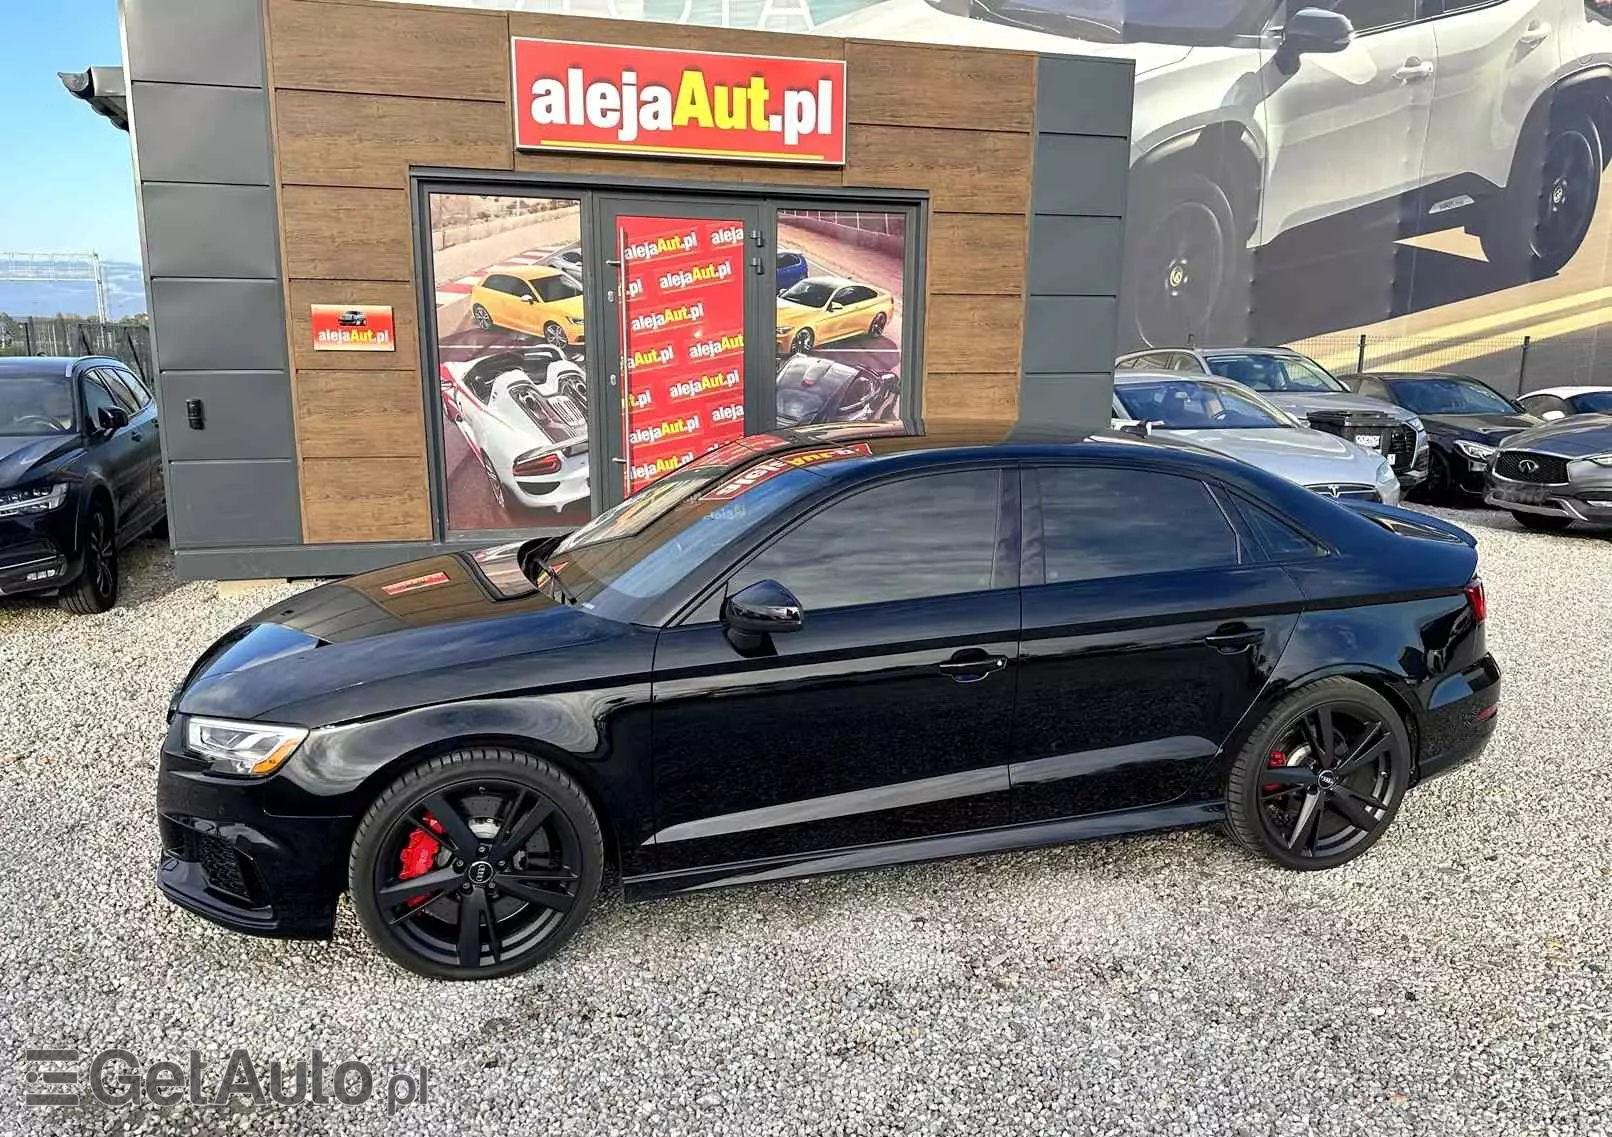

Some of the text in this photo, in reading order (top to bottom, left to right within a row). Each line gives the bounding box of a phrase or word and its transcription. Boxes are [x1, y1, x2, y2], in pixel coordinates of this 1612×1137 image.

[531, 67, 832, 145] alejaAut.pl
[624, 231, 698, 260] alejaAut.pl
[711, 227, 744, 244] aleja
[659, 261, 732, 288] alejaAut.pl
[631, 302, 704, 330] alejaAut.pl
[318, 328, 389, 344] alejaAut.pl
[669, 370, 740, 398] alejaAut.pl
[712, 404, 744, 422] aleja
[629, 416, 700, 444] alejaAut.pl
